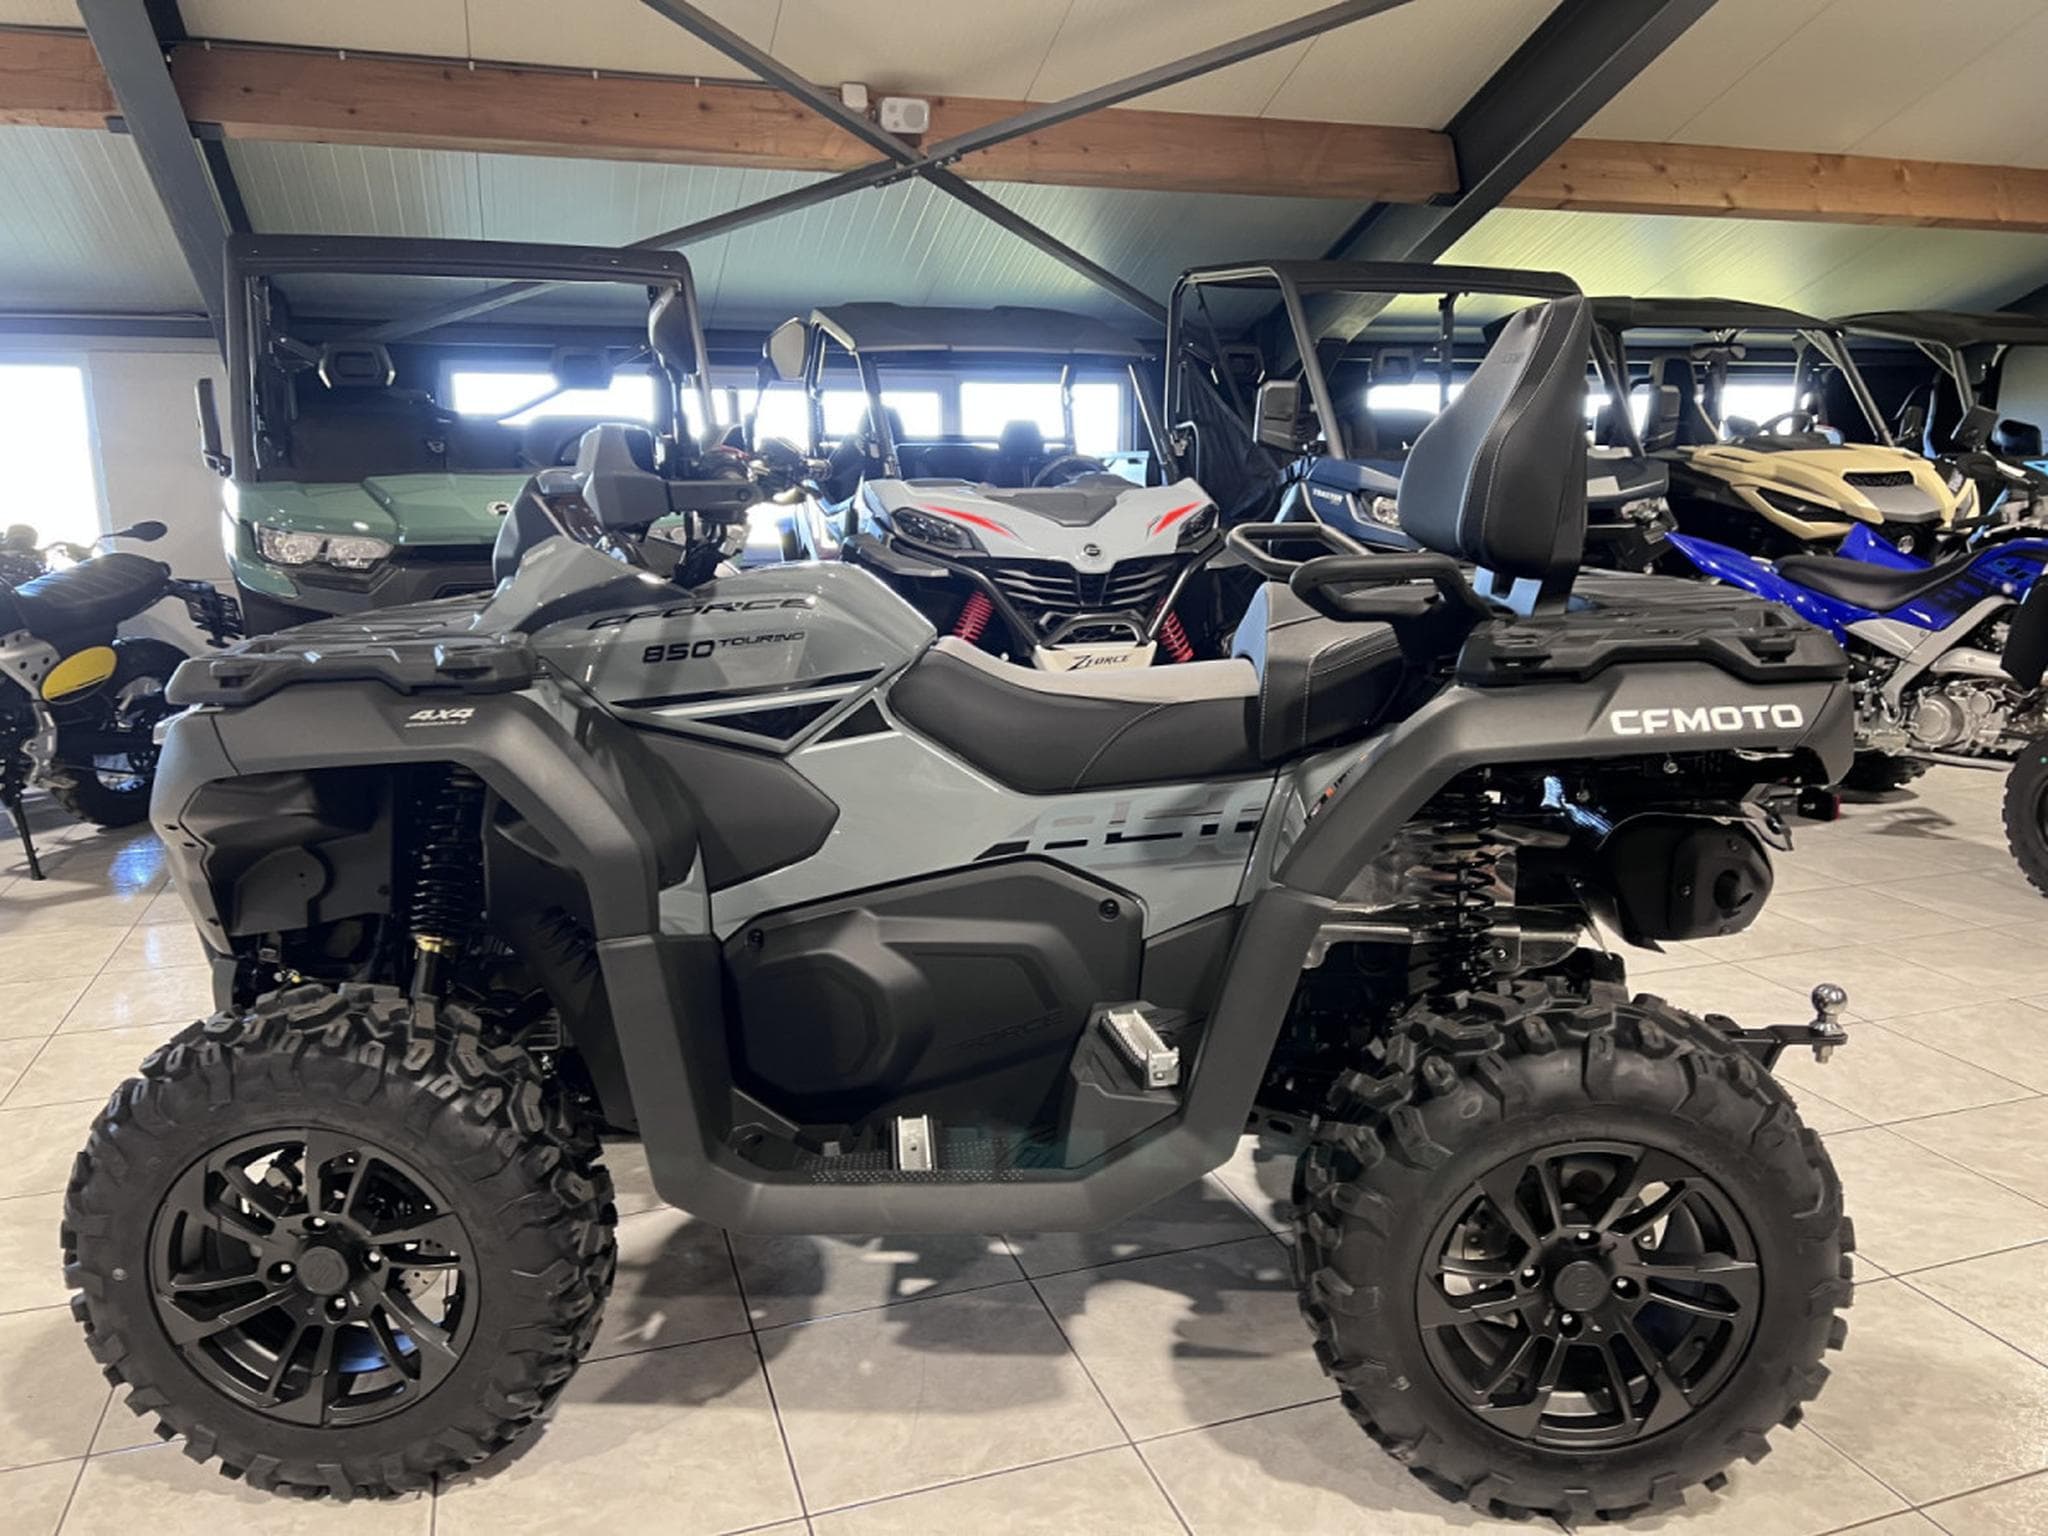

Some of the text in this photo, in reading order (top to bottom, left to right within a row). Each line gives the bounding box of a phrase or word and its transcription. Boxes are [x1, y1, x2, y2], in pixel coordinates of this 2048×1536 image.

[587, 598, 815, 630] CFORCE
[642, 631, 805, 663] 850 TOURING
[1610, 704, 1804, 735] CFMOTO
